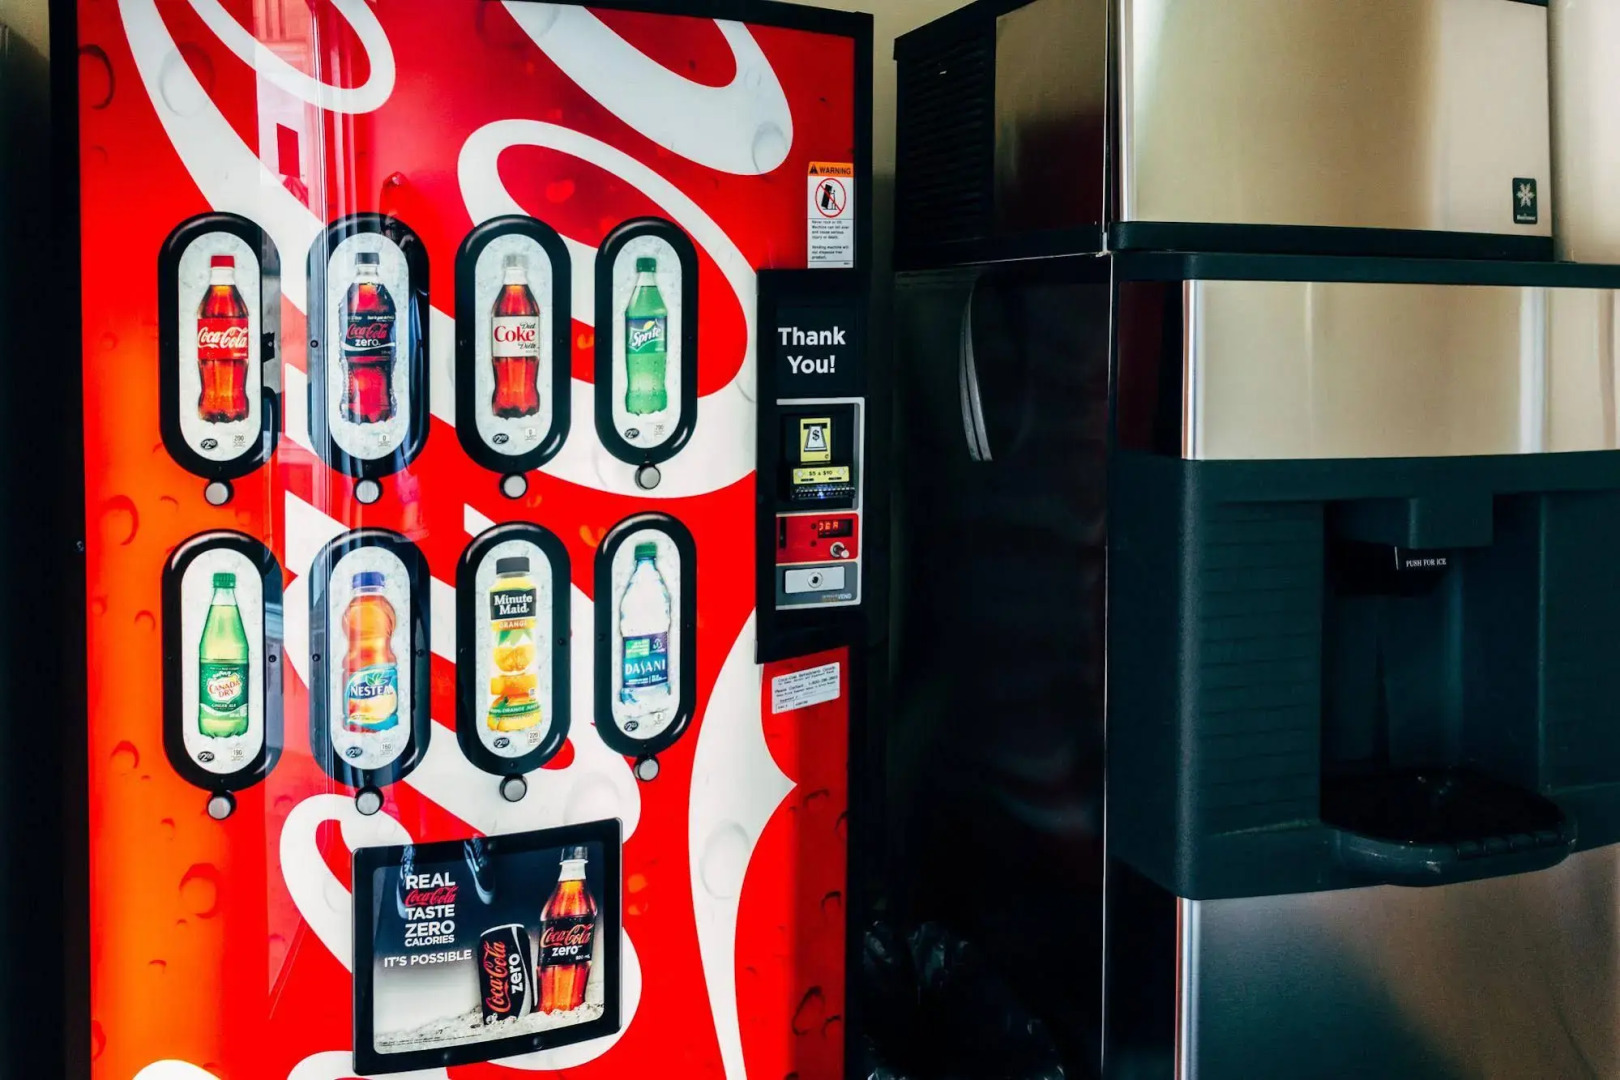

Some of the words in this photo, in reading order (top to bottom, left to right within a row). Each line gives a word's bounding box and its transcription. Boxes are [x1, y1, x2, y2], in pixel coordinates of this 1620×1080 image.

[819, 167, 851, 175] WARNING
[198, 326, 248, 349] Coca-Cola
[346, 323, 389, 340] Coca-Cola
[494, 325, 536, 343] Coke
[631, 327, 662, 348] Sprite
[777, 326, 846, 346] Thank
[787, 355, 836, 374] You!
[1405, 560, 1422, 568] PUSH
[1423, 558, 1435, 567] FOR
[1436, 557, 1447, 566] ICE
[494, 593, 533, 606] Minute
[499, 604, 529, 616] Maid
[625, 659, 666, 676] DASANI
[208, 680, 241, 694] CANADA
[218, 689, 234, 698] DRY
[350, 685, 391, 697] NESTEA
[405, 872, 456, 890] REAL
[404, 885, 459, 908] Coca-Cola
[405, 904, 455, 920] TASTE
[404, 920, 456, 938] ZERO
[539, 923, 595, 948] Coca-Cola
[404, 935, 455, 947] CALORIES
[384, 956, 407, 968] IT'S
[410, 949, 472, 966] POSSIBLE
[551, 945, 579, 957] zero
[483, 940, 512, 1014] Coca-Cola
[508, 953, 524, 995] zero
